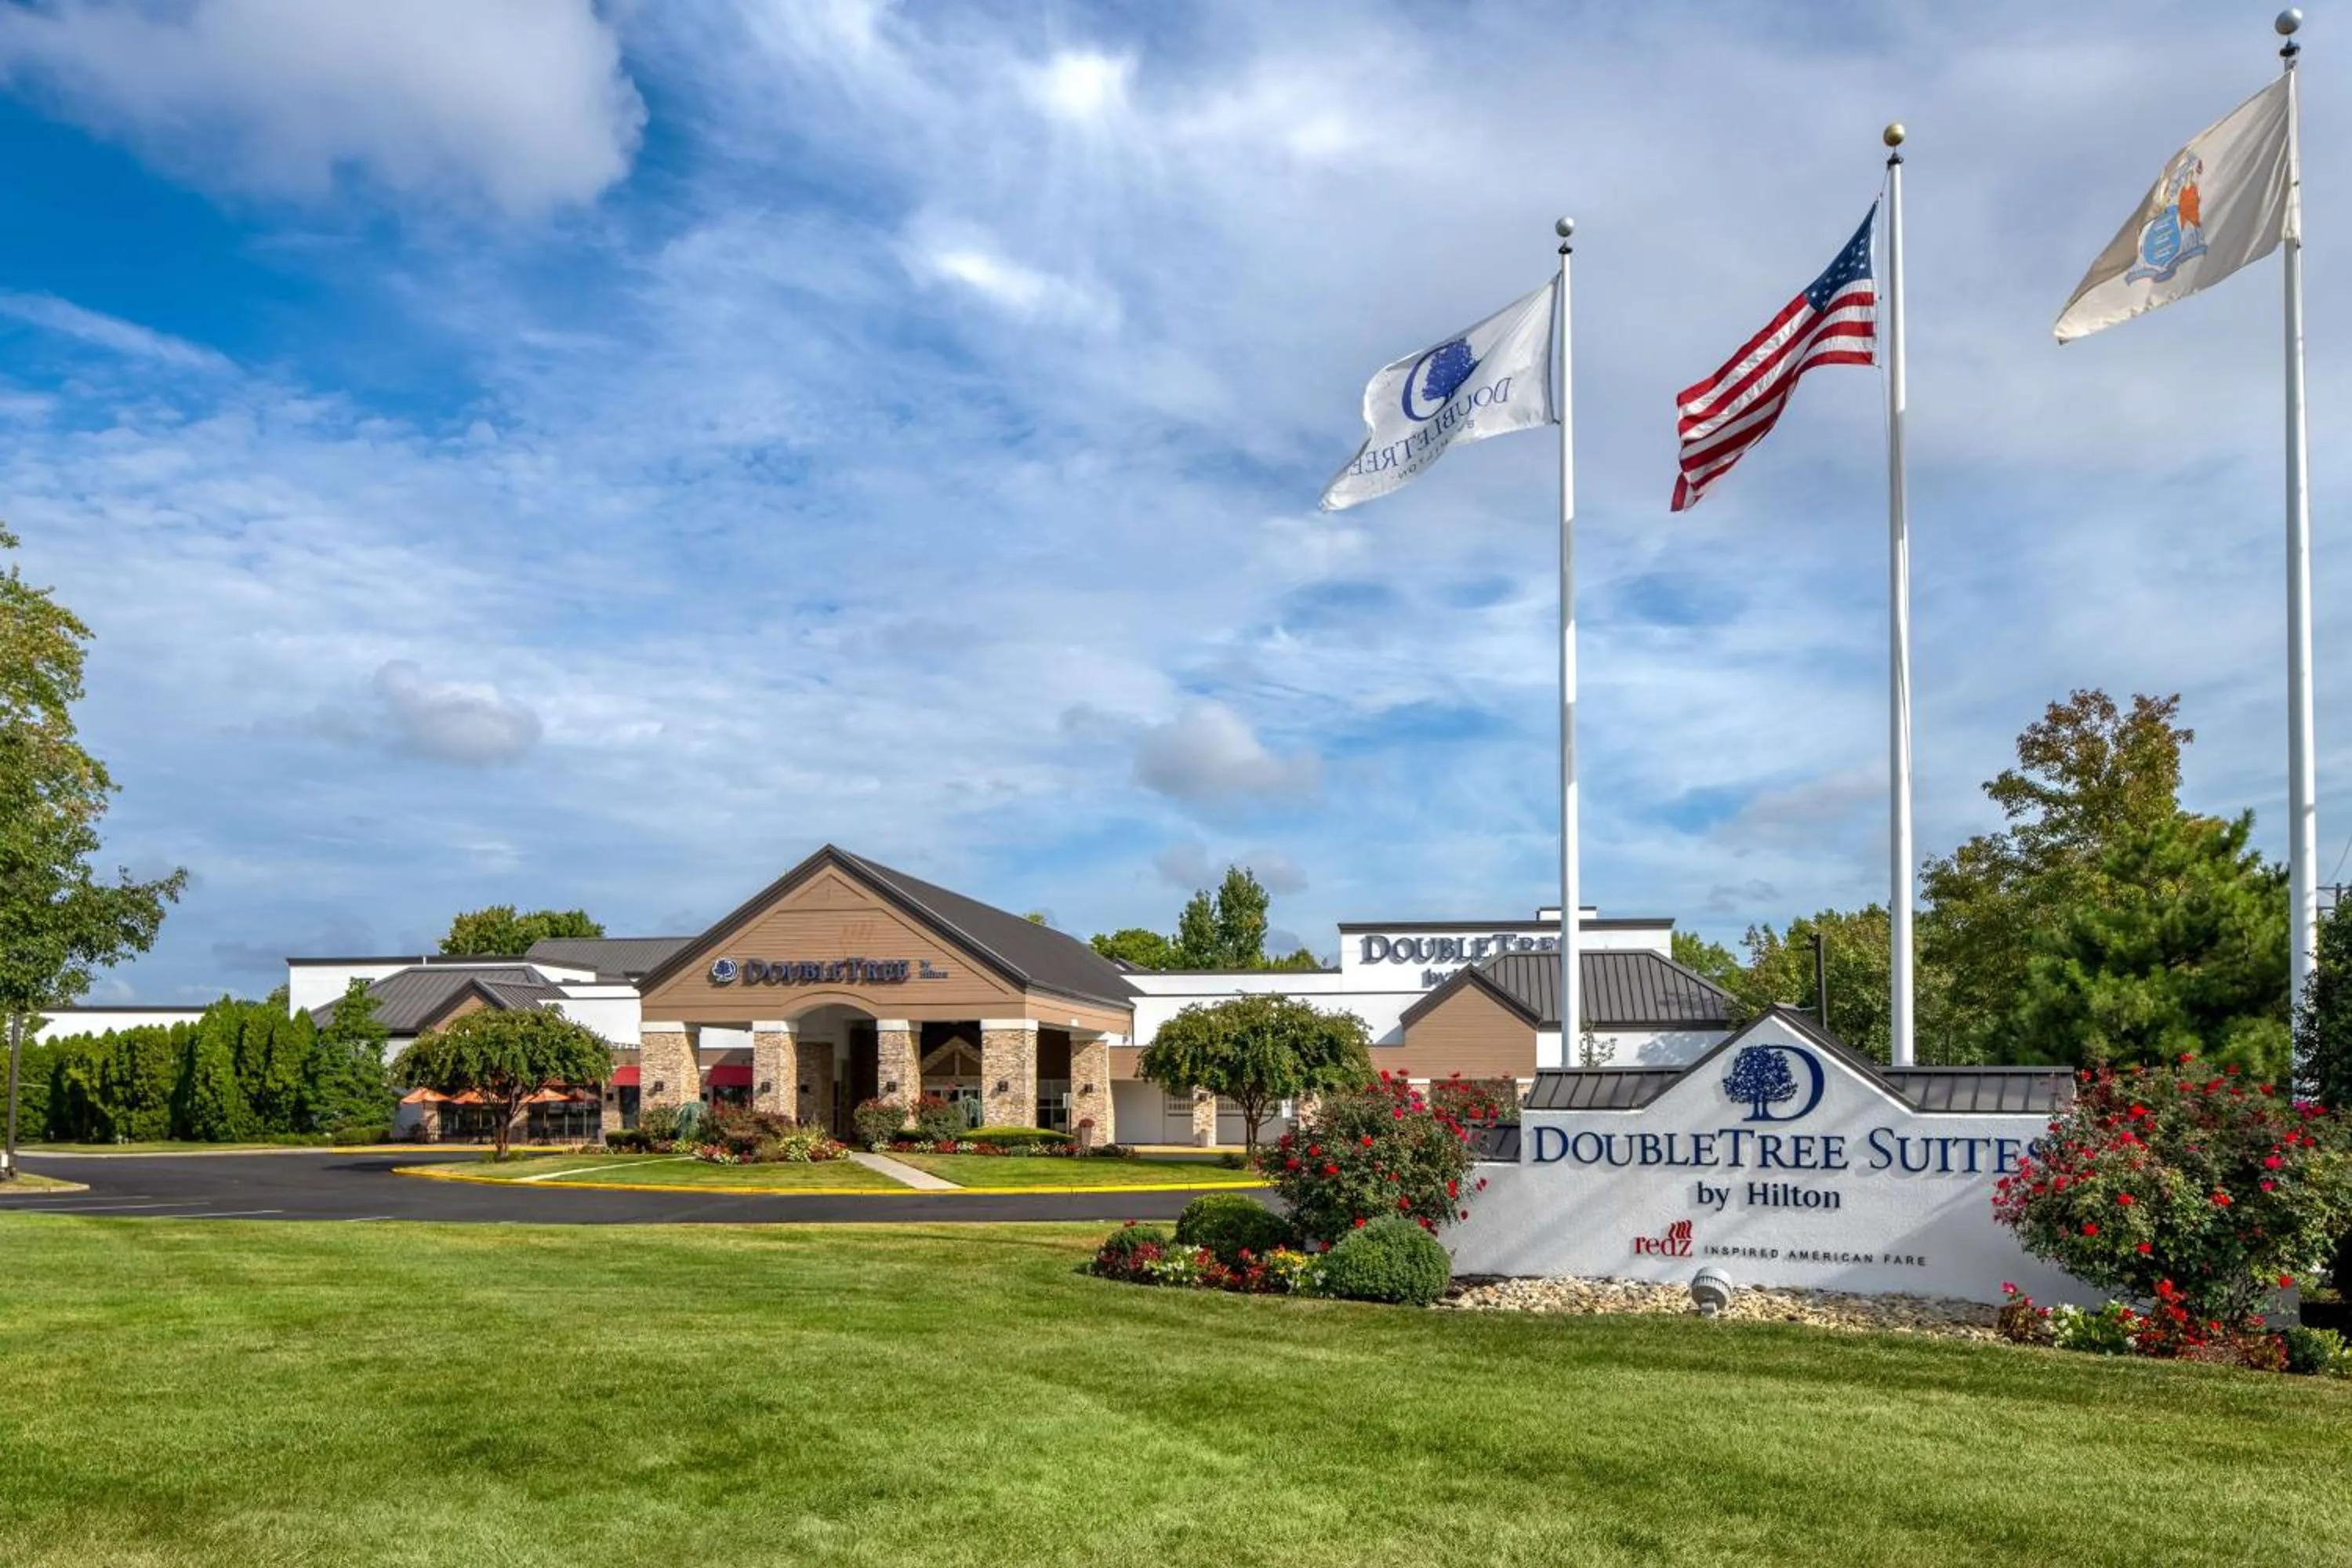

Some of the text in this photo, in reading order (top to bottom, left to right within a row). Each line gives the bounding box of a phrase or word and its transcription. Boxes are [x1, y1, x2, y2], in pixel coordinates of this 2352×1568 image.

[1362, 934, 1561, 964] DOUBLETRE
[746, 957, 910, 982] DOUBLETREE
[1533, 1126, 1849, 1170] DOUBLETREE
[1697, 1181, 1841, 1211] by Hilton
[1634, 1220, 1926, 1266] redz INSPIRED AMERICAN FARE
